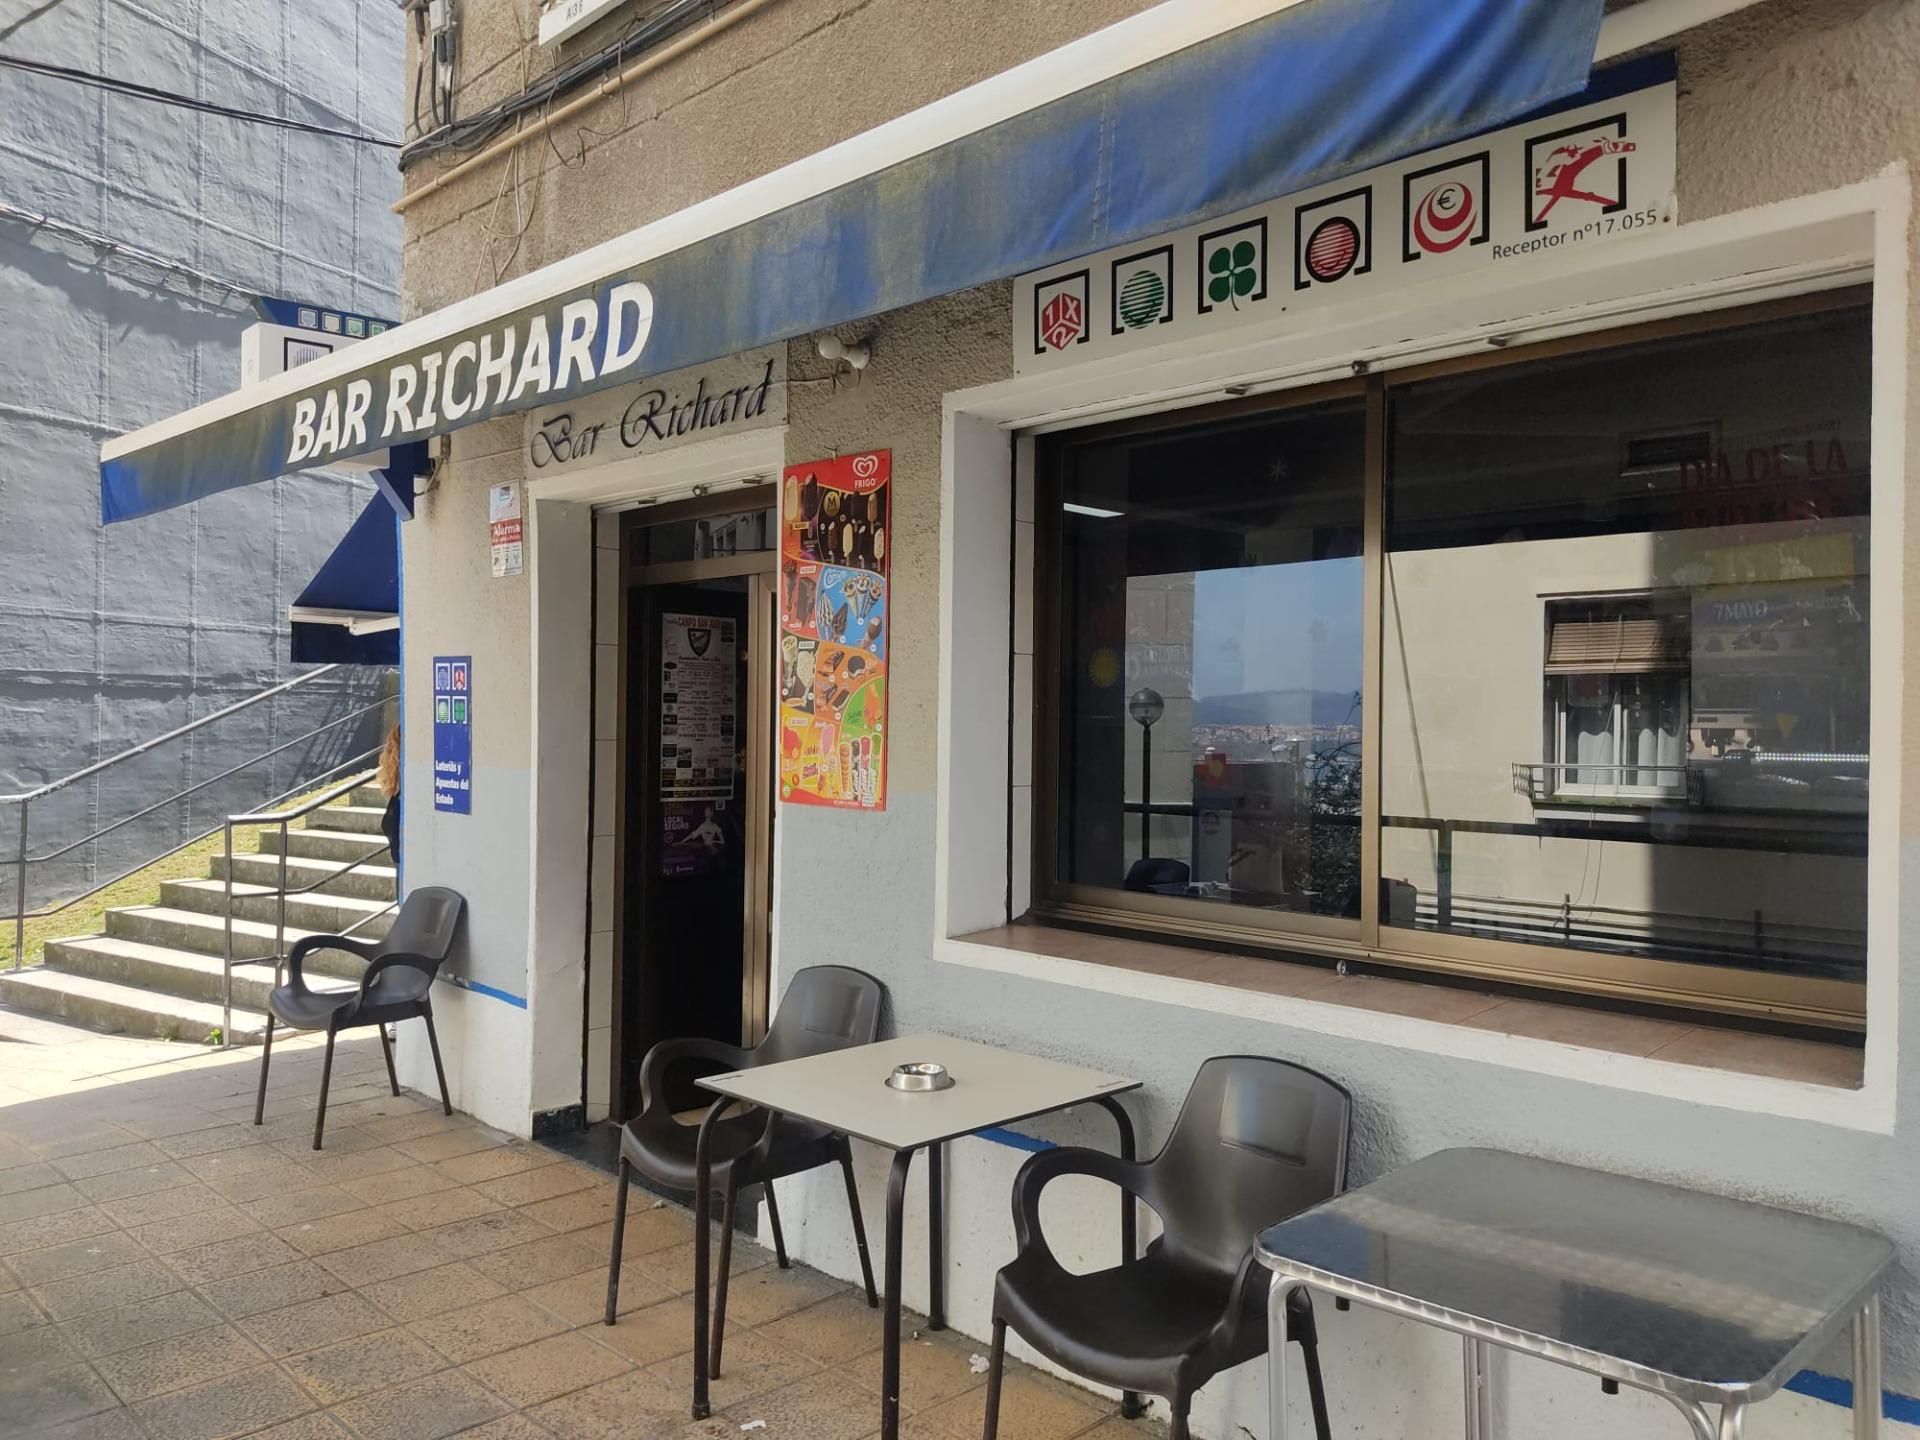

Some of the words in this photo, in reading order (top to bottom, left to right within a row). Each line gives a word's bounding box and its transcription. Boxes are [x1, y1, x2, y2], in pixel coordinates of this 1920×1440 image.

[1492, 231, 1568, 260] Receptor
[286, 378, 372, 465] BAR
[381, 281, 655, 439] RICHARD
[530, 413, 605, 469] Bar
[619, 357, 775, 449] Richard
[1807, 436, 1848, 474] LA
[854, 477, 877, 489] FRIGO
[494, 523, 520, 537] Alarma
[436, 776, 459, 790] Apuestas
[460, 777, 469, 790] del
[436, 792, 454, 805] Estado
[664, 816, 684, 824] LOCAL
[664, 822, 690, 831] SEGURO
